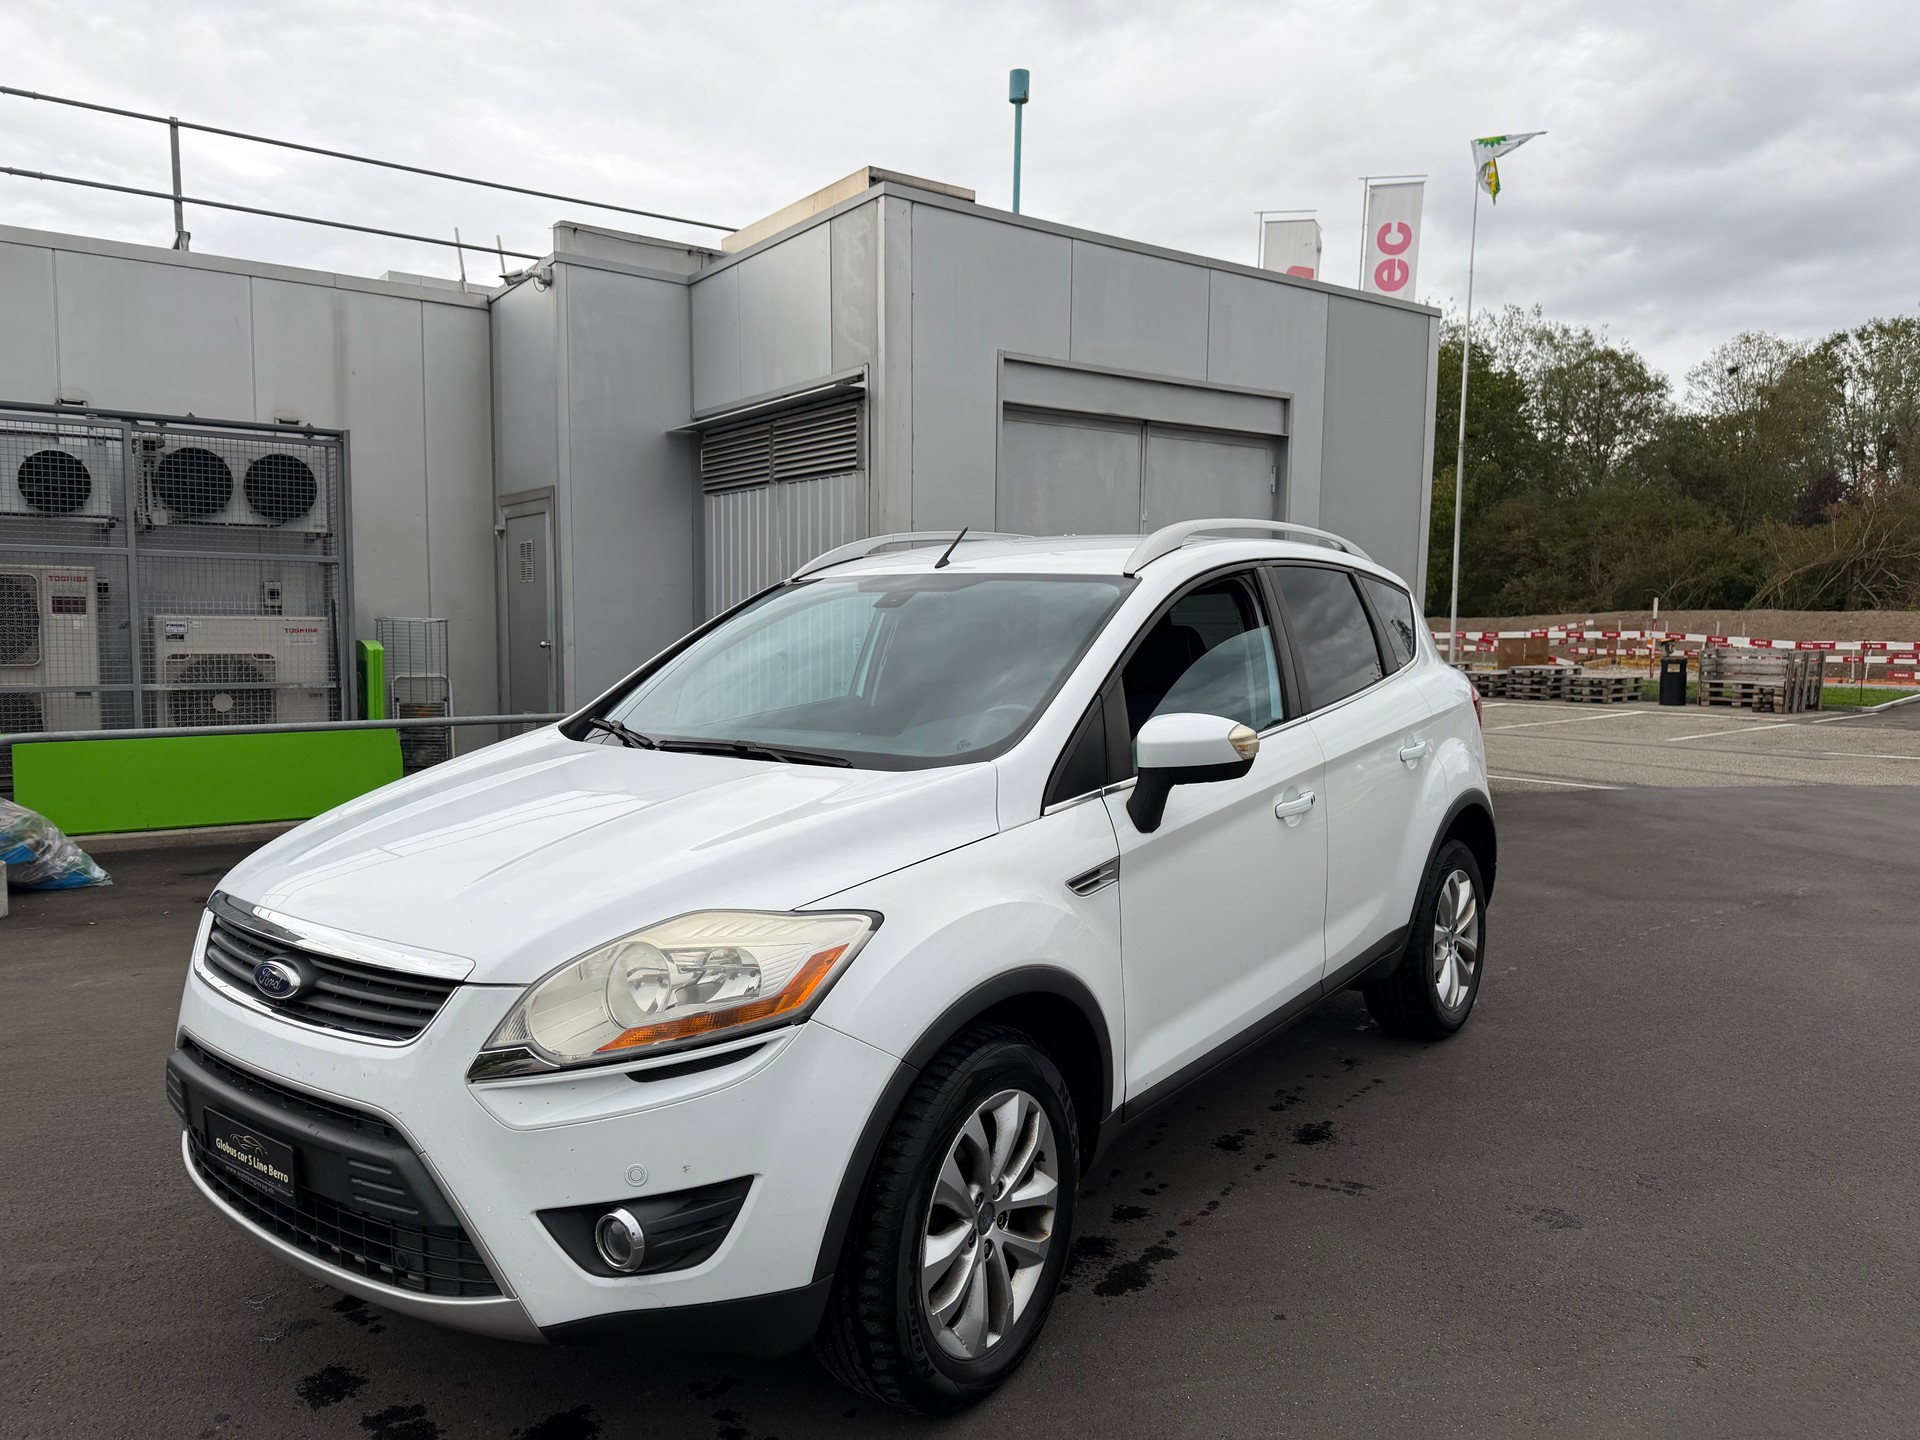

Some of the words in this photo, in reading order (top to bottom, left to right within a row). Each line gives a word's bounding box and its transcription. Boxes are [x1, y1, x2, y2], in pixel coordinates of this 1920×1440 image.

[48, 575, 88, 583] TOSHIBA
[258, 967, 281, 990] Ford
[215, 1137, 237, 1158] Globus
[237, 1151, 248, 1163] car
[253, 1156, 268, 1174] Line
[268, 1164, 289, 1183] Berro
